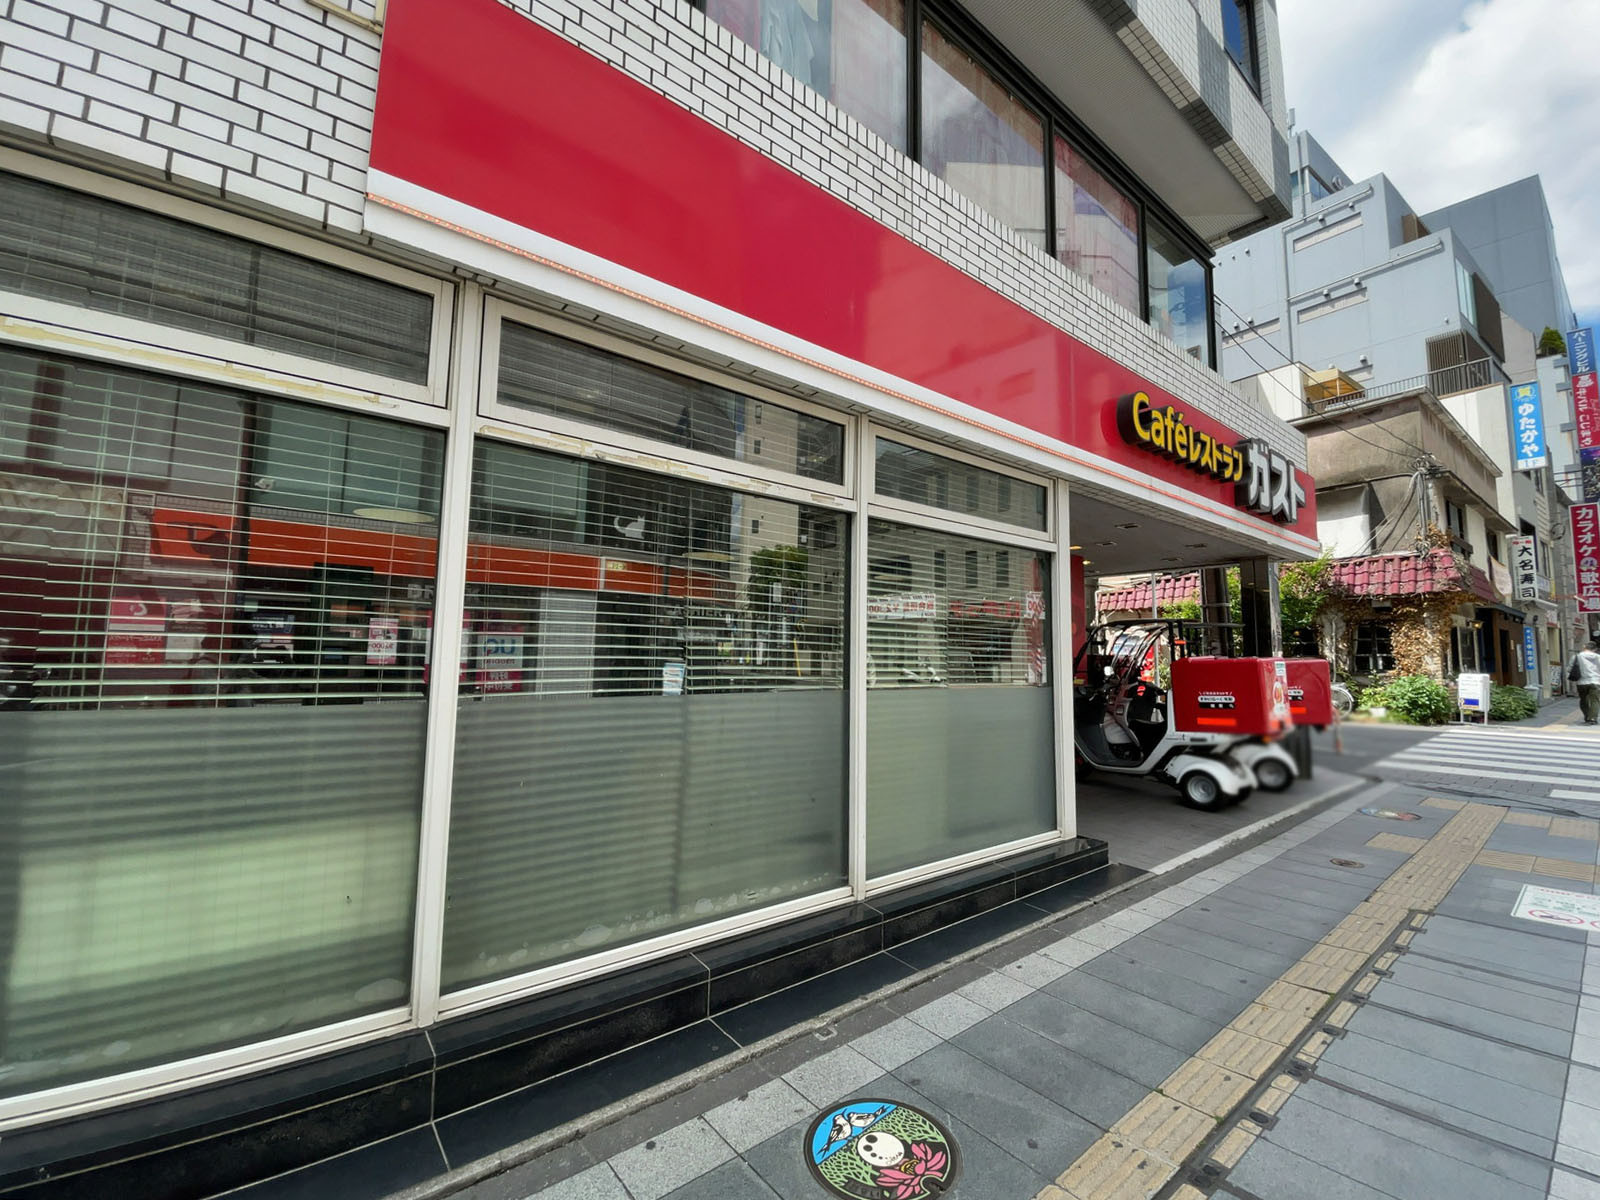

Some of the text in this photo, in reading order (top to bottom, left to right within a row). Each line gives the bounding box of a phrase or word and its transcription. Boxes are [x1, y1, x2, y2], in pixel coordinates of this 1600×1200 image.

[1248, 438, 1306, 522] ガスト
[1518, 545, 1536, 598] 大名寿司
